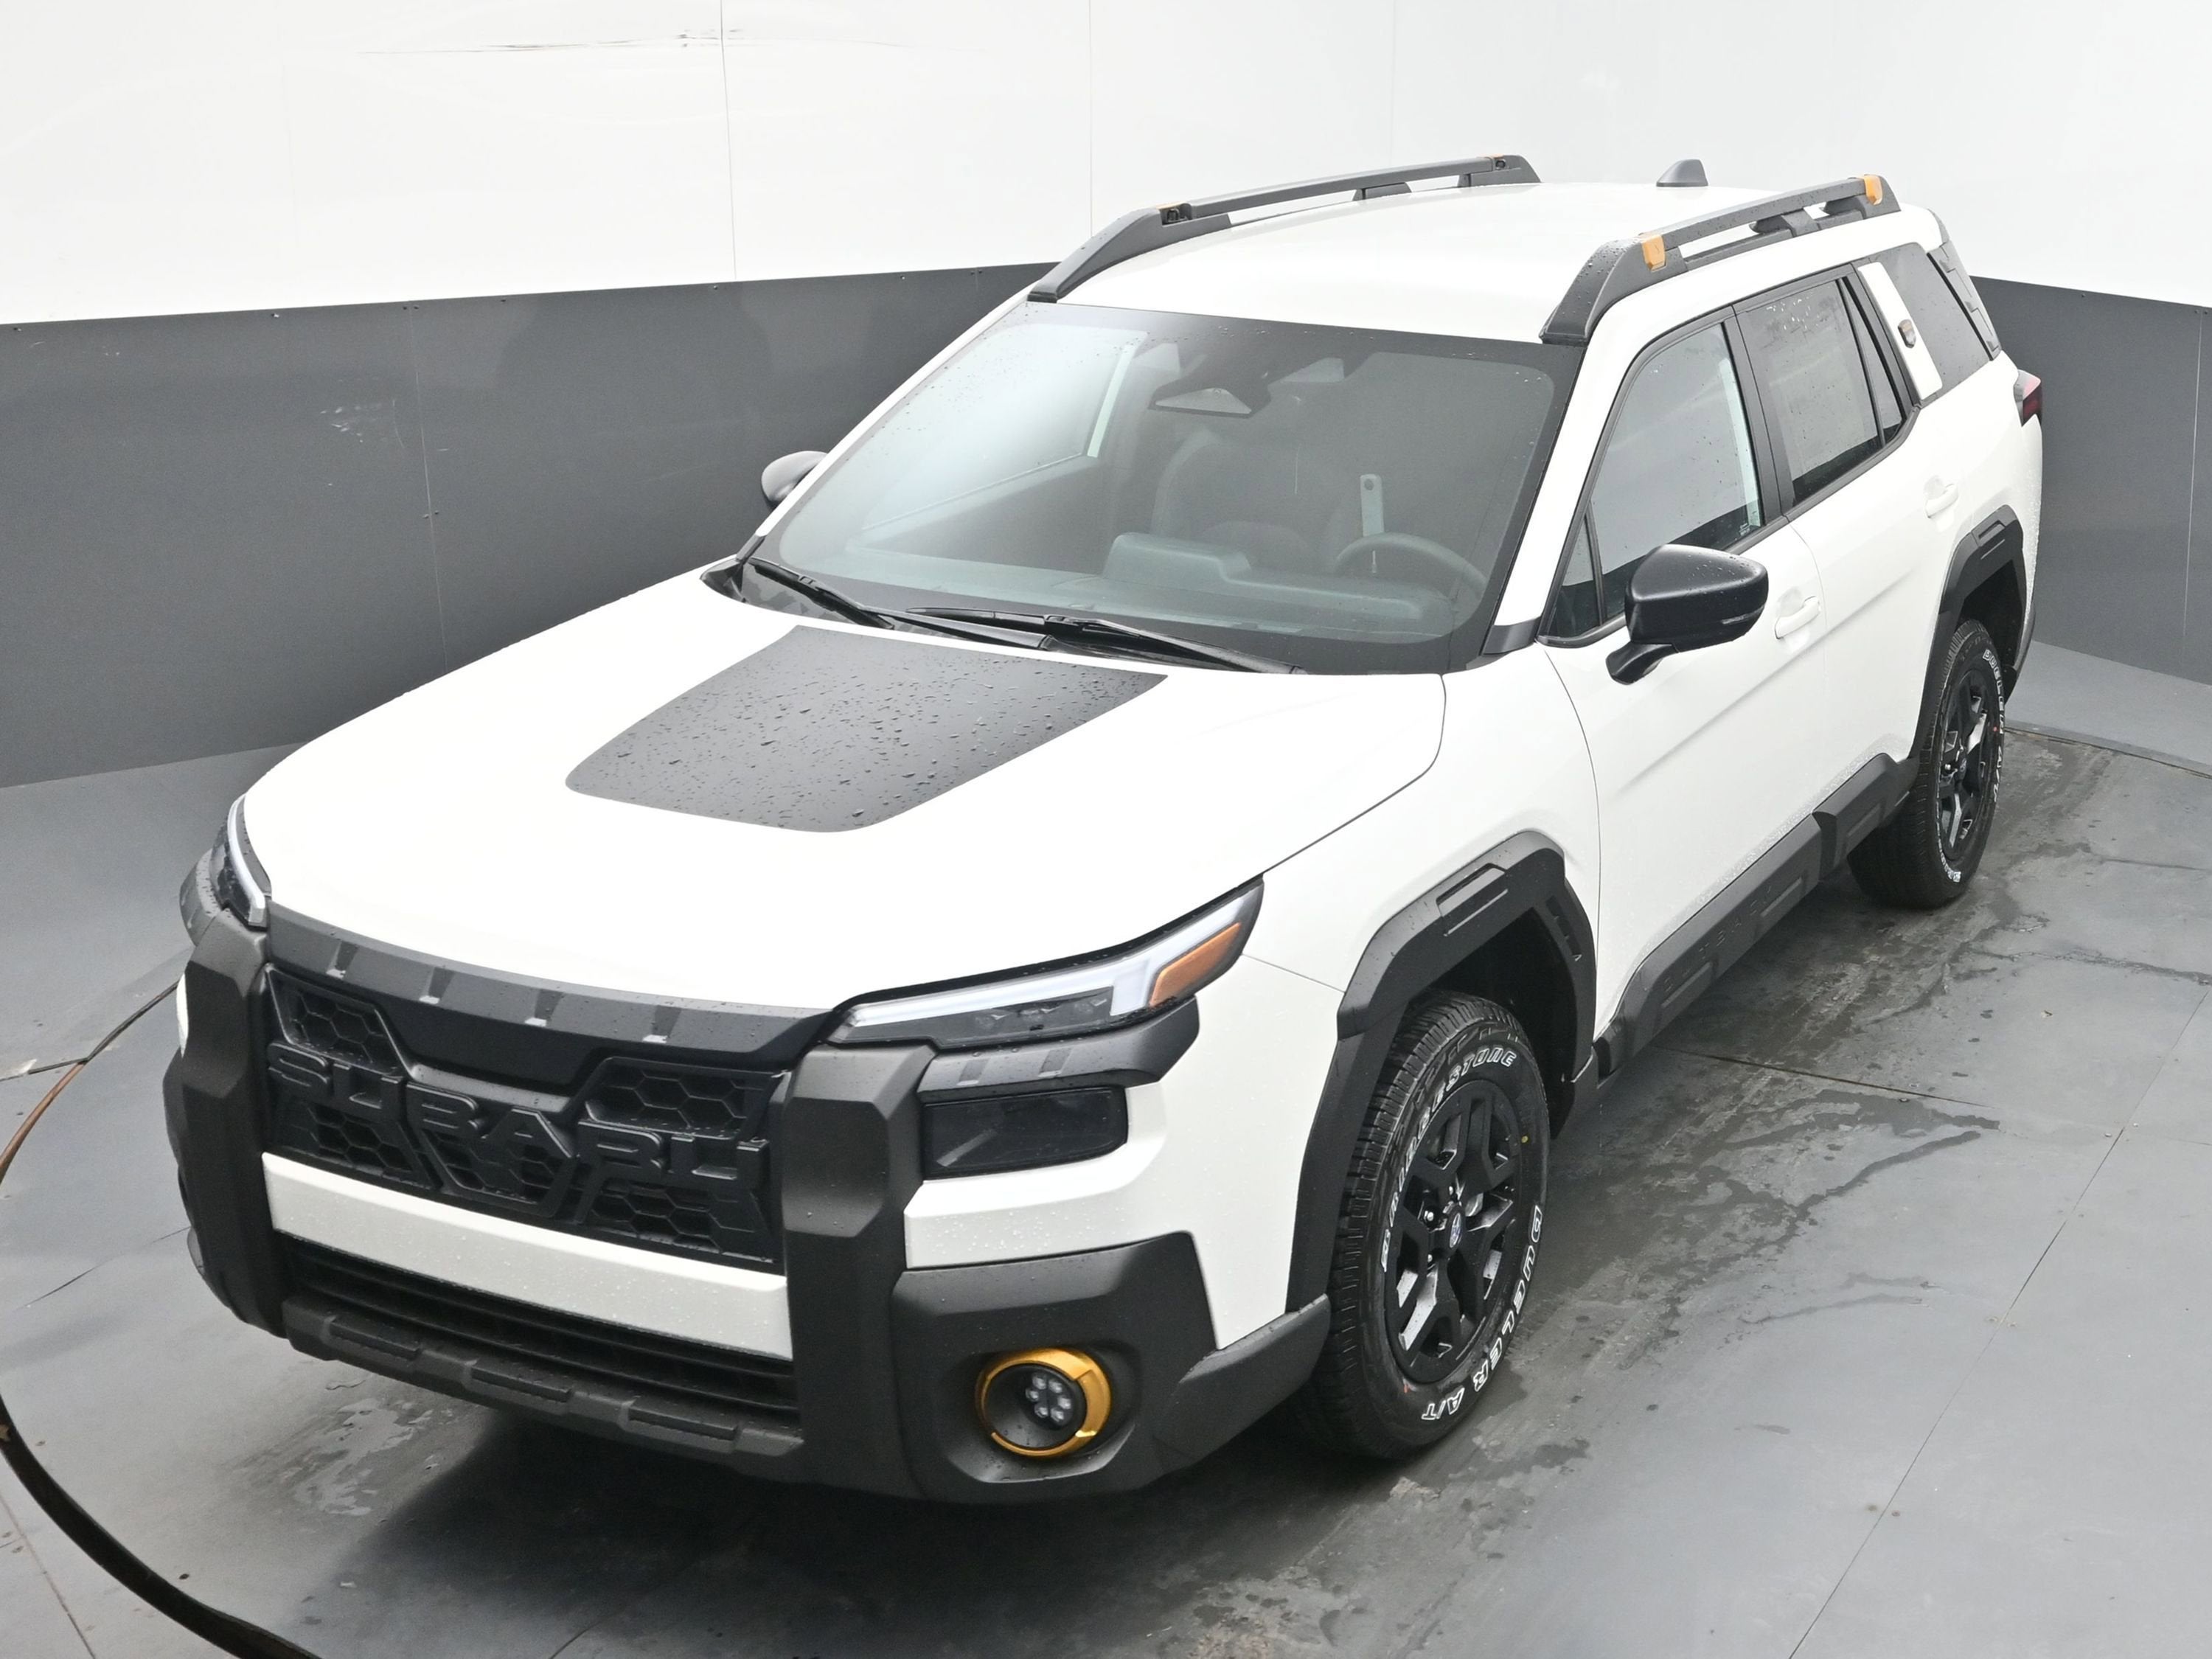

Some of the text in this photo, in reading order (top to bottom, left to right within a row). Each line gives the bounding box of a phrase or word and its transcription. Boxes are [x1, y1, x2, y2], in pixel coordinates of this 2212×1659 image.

[266, 1038, 771, 1196] SUBARU
[1380, 1046, 1517, 1273] BRIDGESTONE
[1421, 1204, 1543, 1420] DUELER A/T
